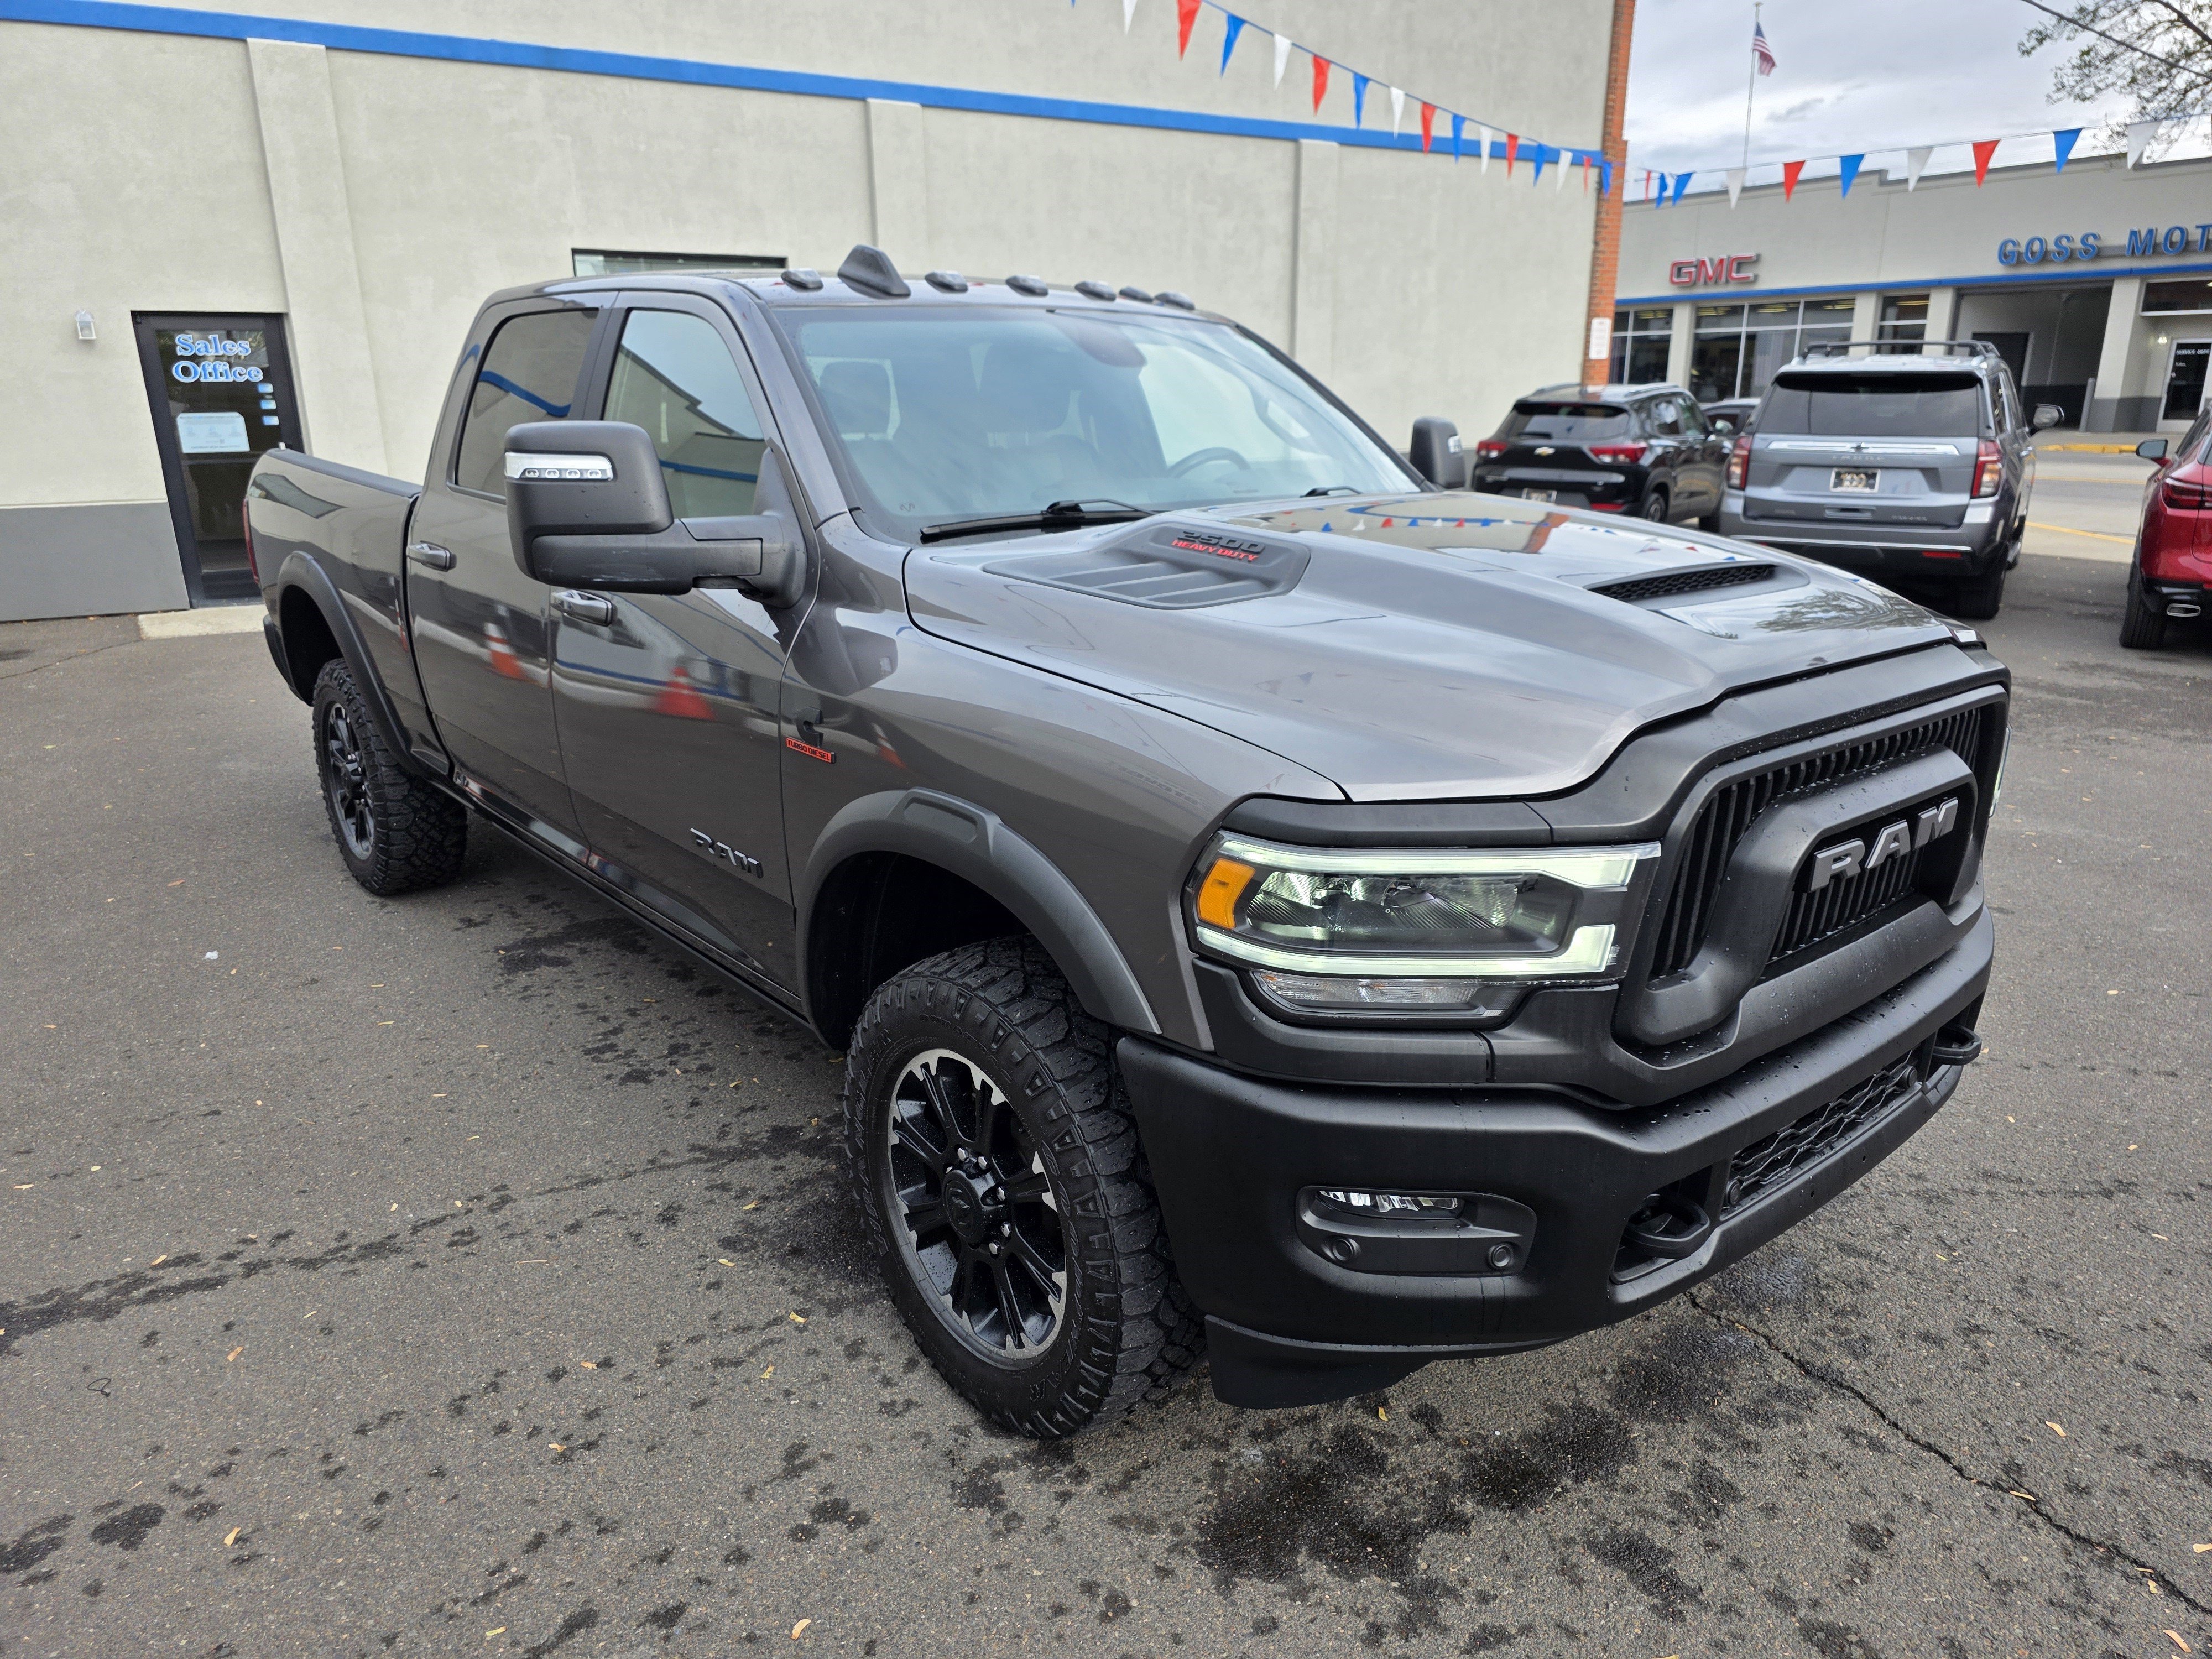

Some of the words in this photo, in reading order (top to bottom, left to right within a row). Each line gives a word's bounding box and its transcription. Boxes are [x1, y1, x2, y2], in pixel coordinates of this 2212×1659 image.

[1997, 232, 2100, 267] GOSS
[2125, 223, 2212, 257] MOT
[1670, 253, 1759, 286] GMC
[175, 334, 251, 356] Sales
[172, 361, 263, 383] Office
[1171, 540, 1217, 554] HEAVY
[1216, 549, 1259, 562] DUTY
[1177, 531, 1265, 553] 2500
[787, 739, 807, 753] TURBO
[808, 747, 832, 761] DIESEL
[690, 828, 764, 879] RAM
[1808, 797, 1958, 893] RAM
